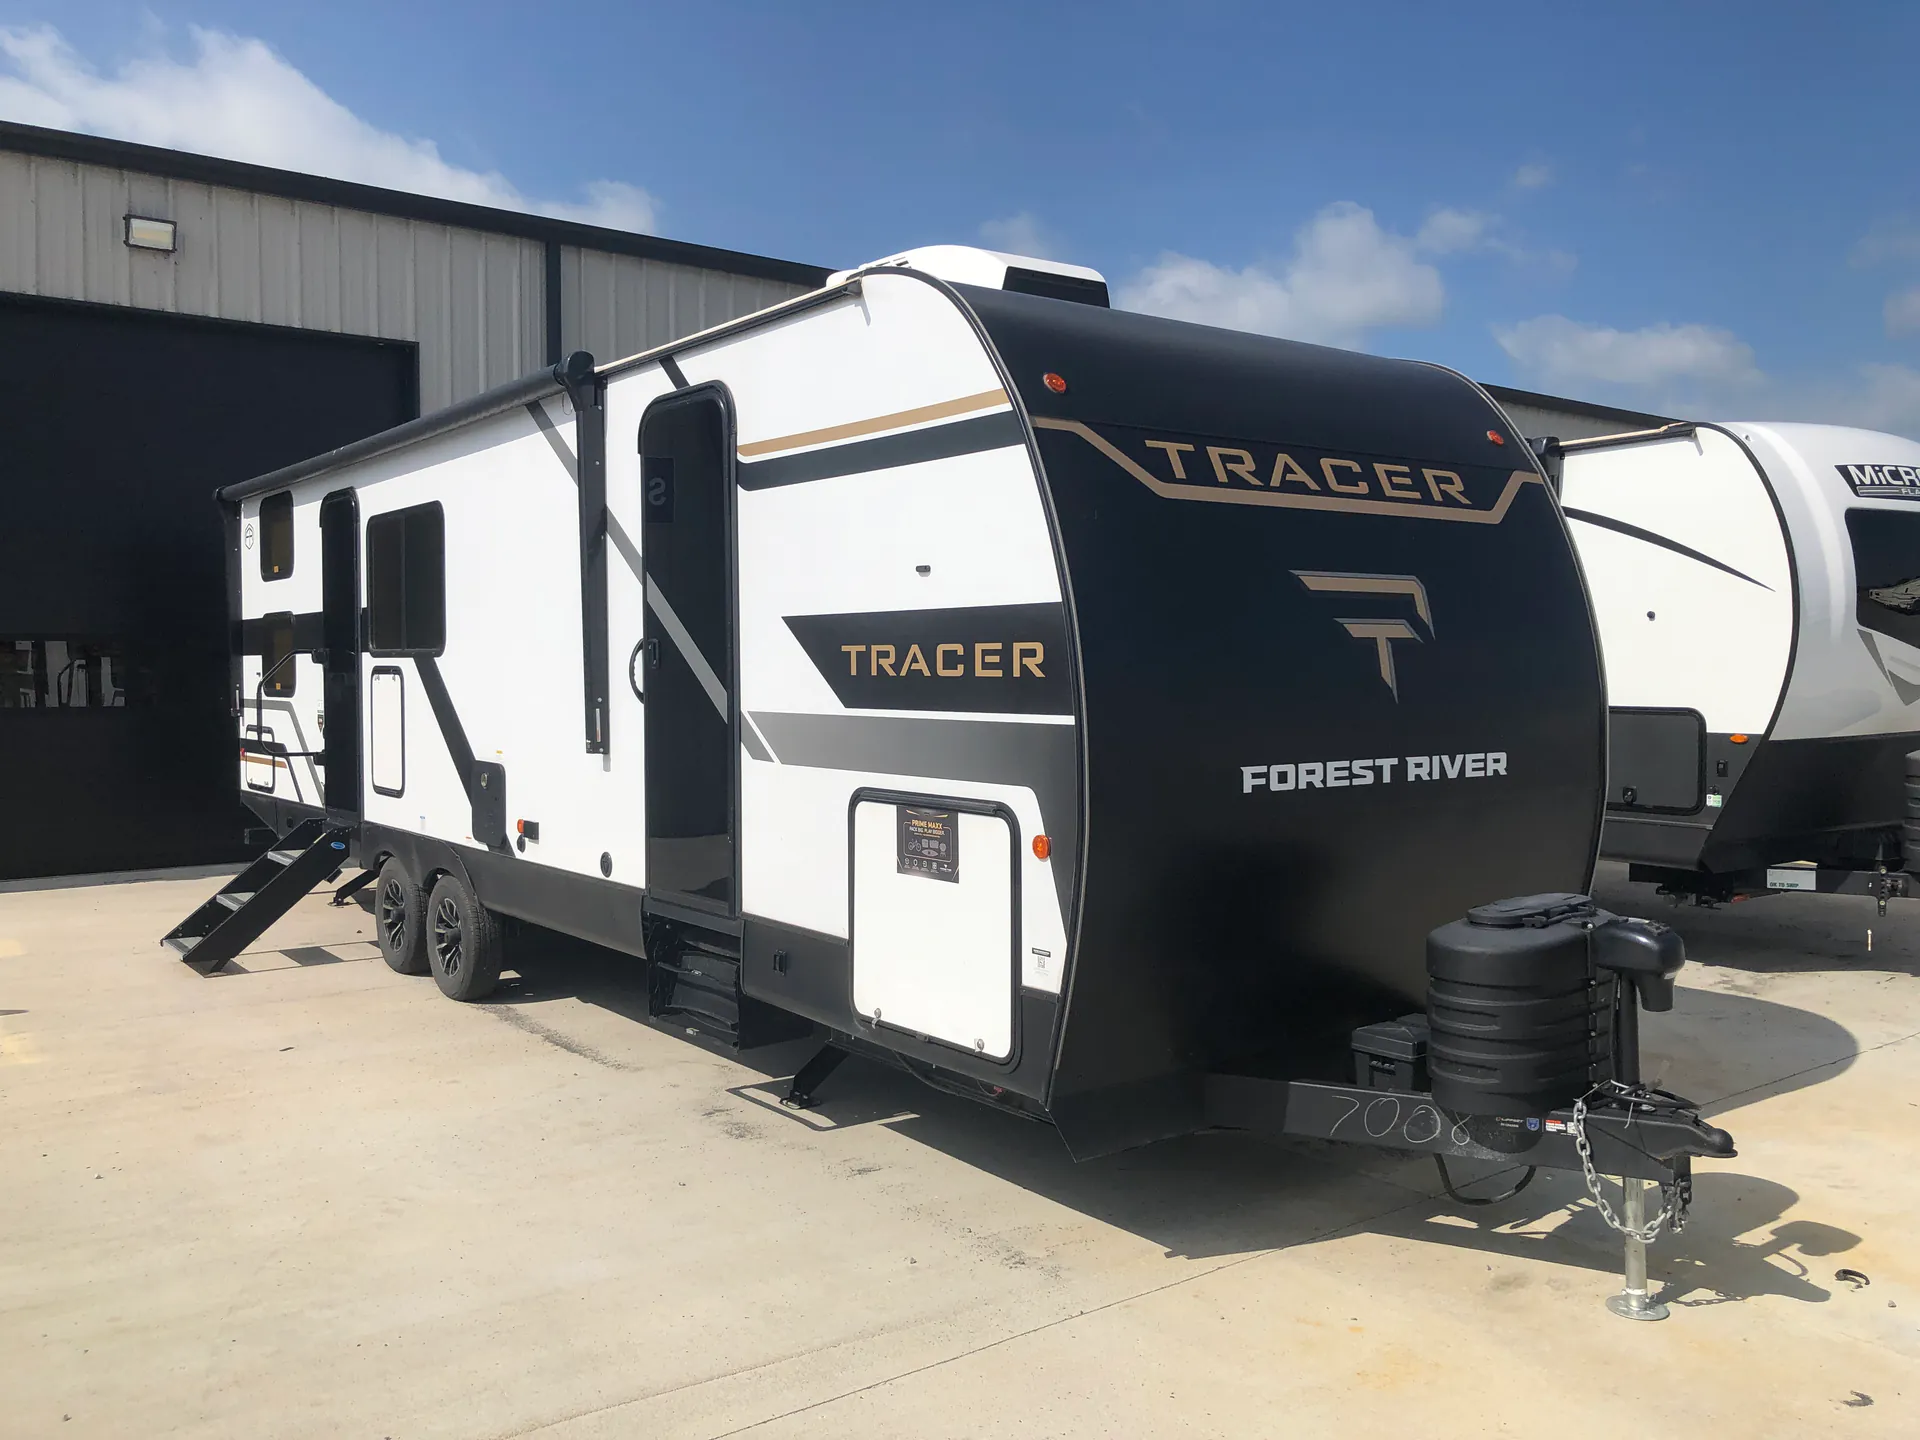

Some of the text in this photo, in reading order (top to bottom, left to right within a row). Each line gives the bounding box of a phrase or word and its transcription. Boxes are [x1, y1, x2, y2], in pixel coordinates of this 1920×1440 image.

[1144, 439, 1473, 505] TRACER
[841, 641, 1046, 678] TRACER
[1240, 752, 1508, 794] FOREST RIVER
[1329, 1095, 1472, 1146] 7008
